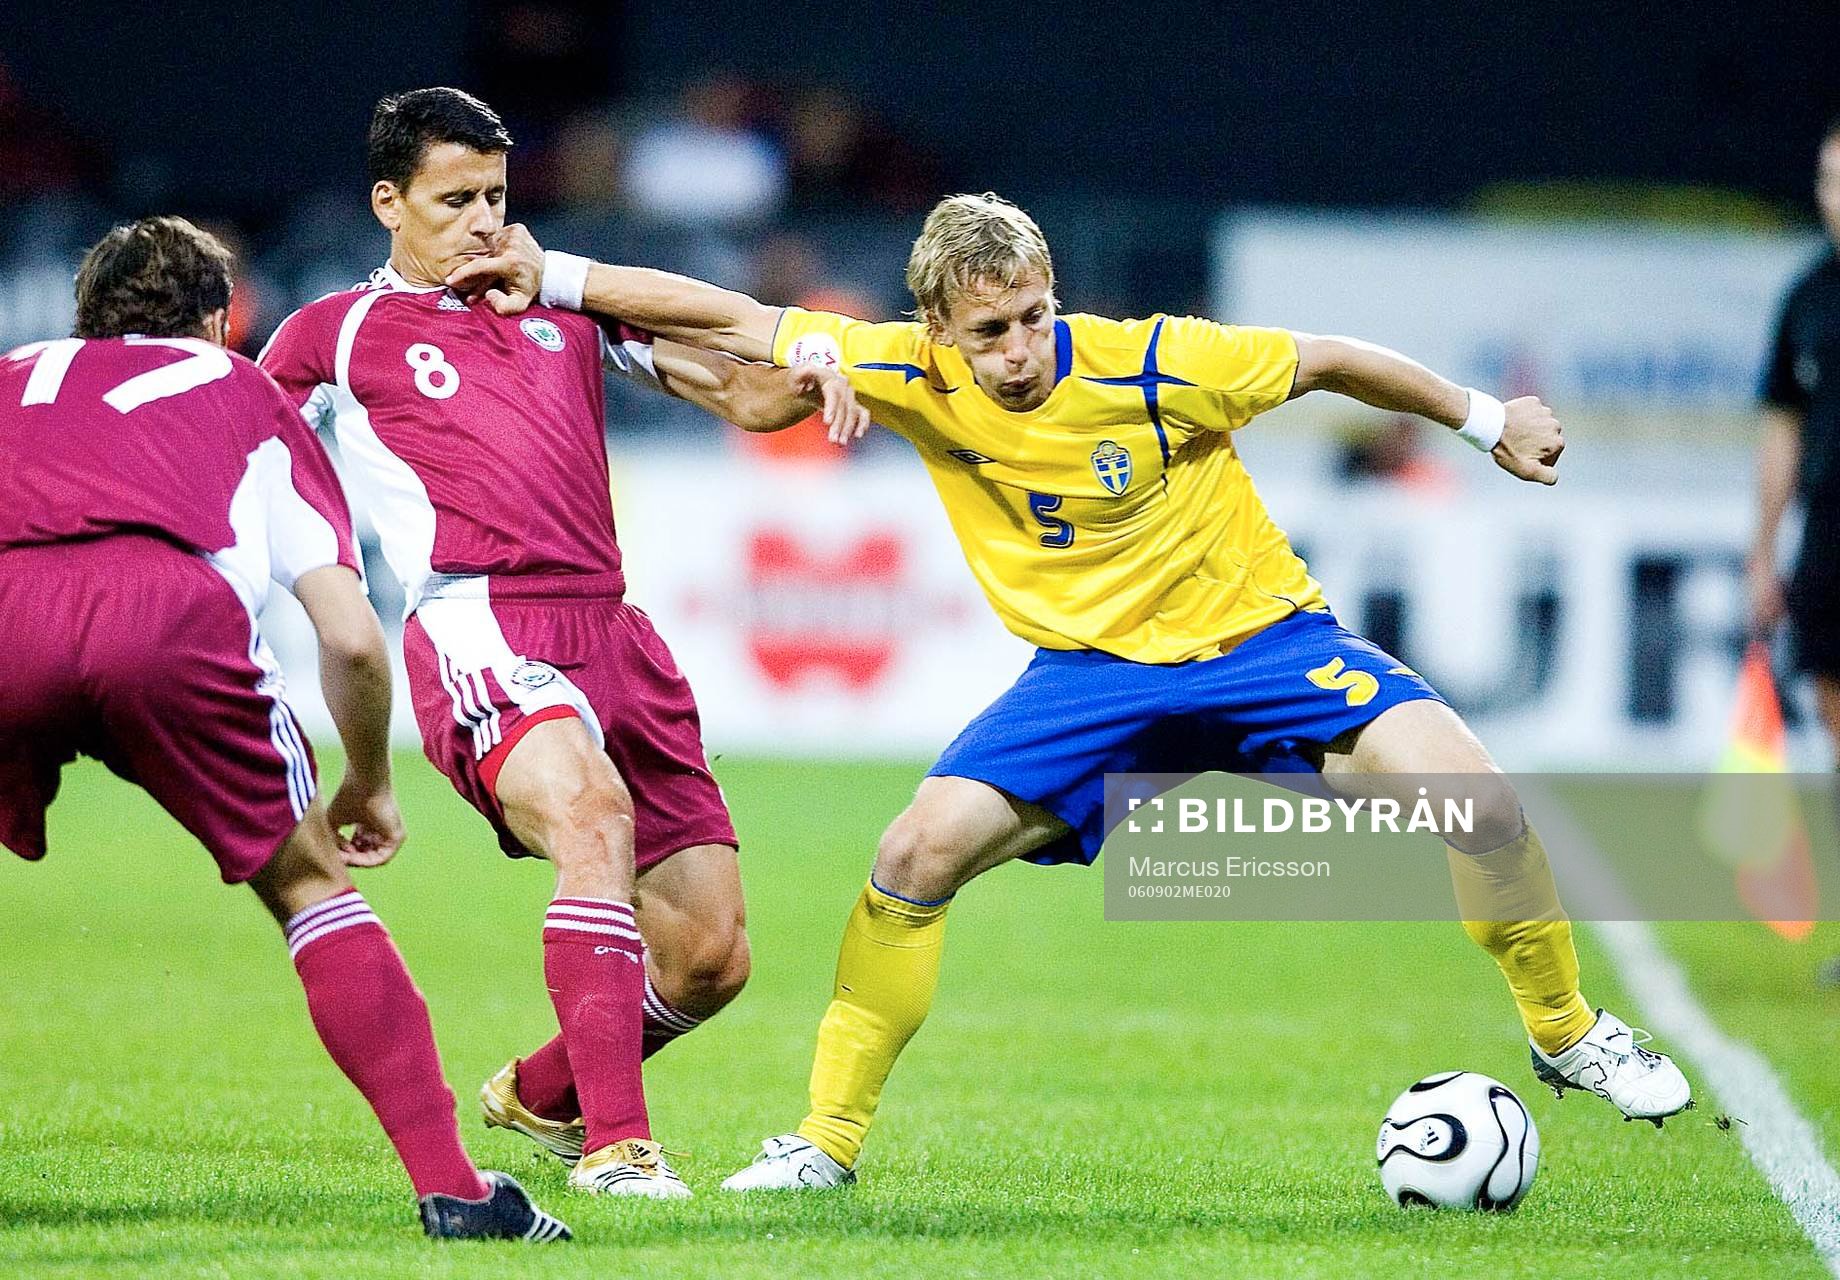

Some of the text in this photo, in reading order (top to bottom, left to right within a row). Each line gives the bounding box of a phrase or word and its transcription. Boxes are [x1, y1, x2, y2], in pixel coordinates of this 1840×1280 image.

[404, 342, 461, 400] 8
[1027, 492, 1074, 549] 5
[1304, 656, 1380, 707] 5
